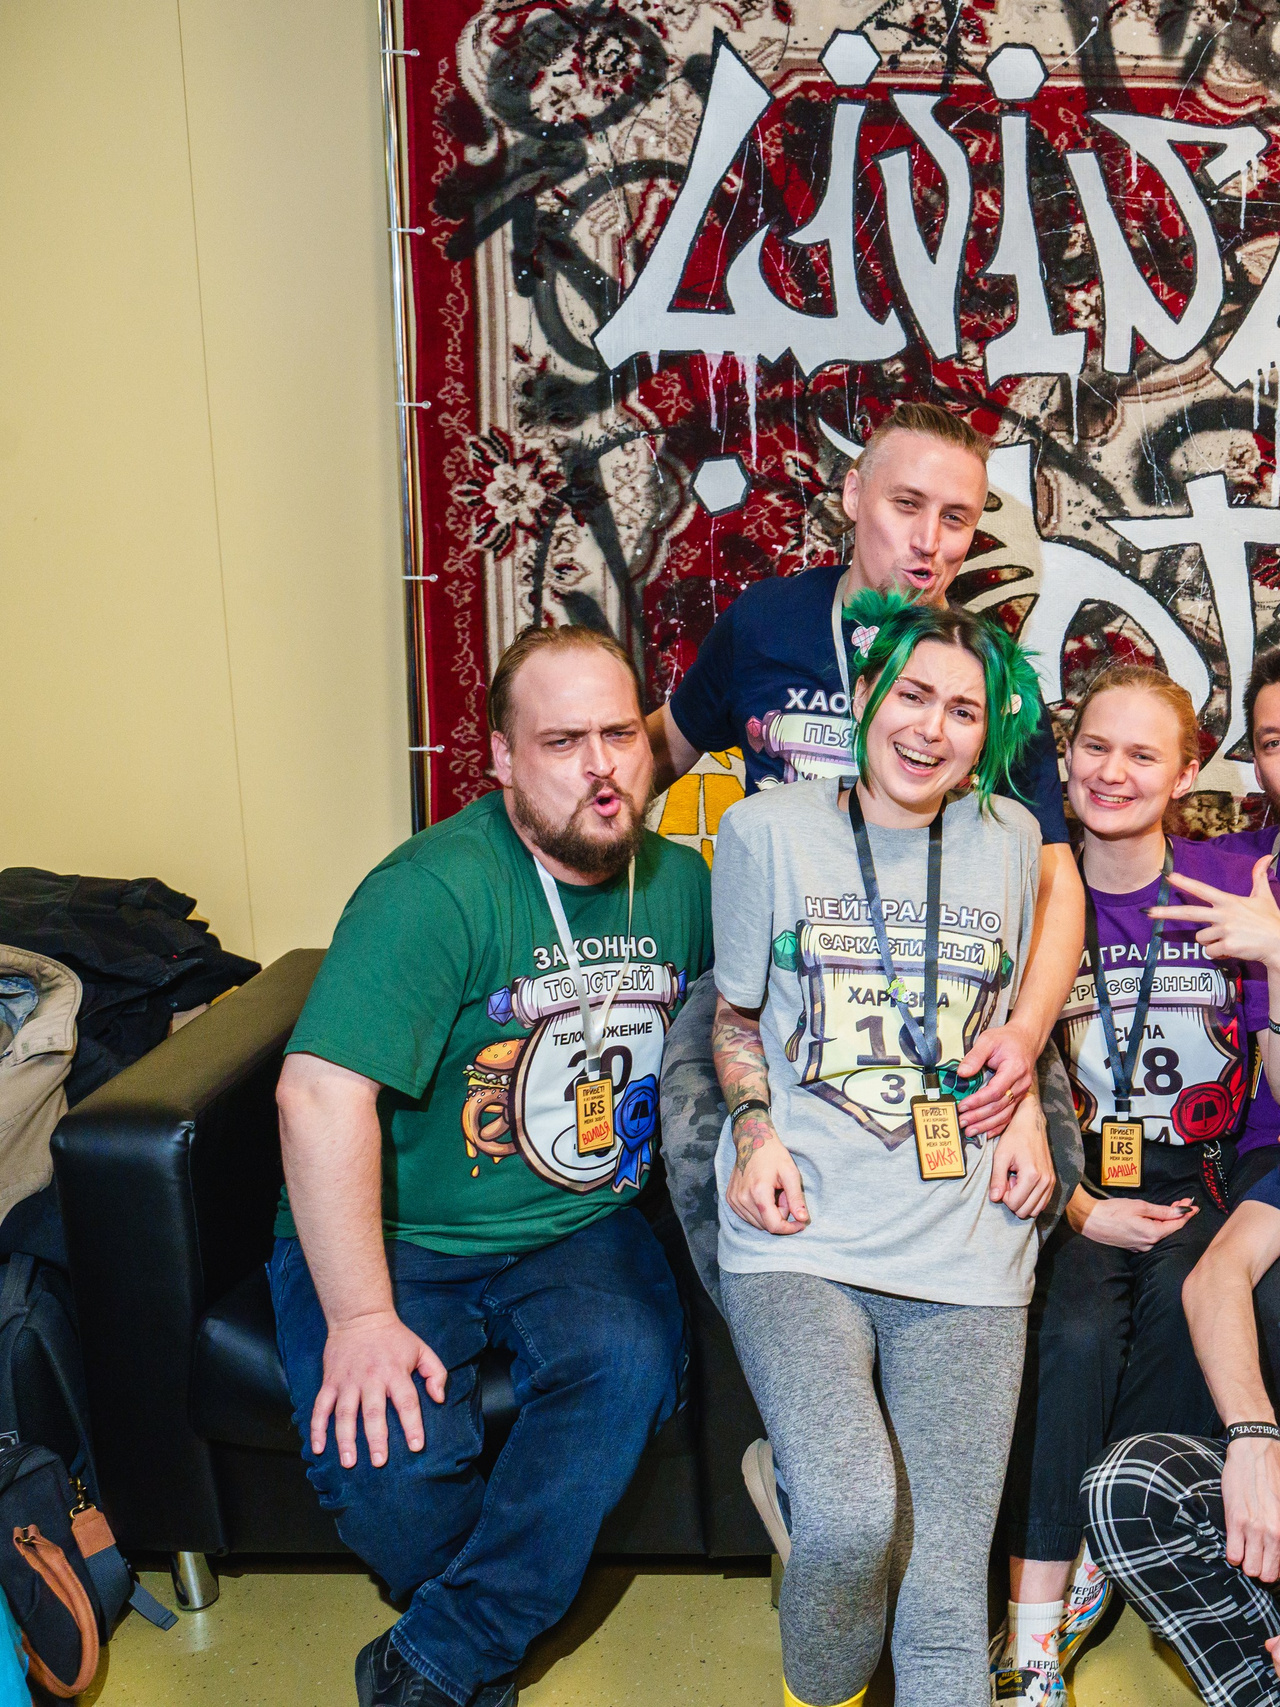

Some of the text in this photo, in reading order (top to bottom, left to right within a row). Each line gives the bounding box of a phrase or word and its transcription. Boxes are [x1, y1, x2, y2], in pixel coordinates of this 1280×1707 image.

[819, 933, 985, 964] САРКАСТИНЫЙ
[848, 986, 950, 1008] ХАРЗА
[553, 1022, 653, 1046] ТЕЛОСЖЕНИЕ
[880, 1074, 906, 1105] 3
[584, 1100, 605, 1117] LRS
[582, 1121, 610, 1145] ВОЛОДЯ
[925, 1124, 950, 1140] LRS
[925, 1147, 958, 1171] ВИКА
[1110, 1141, 1133, 1155] LRS
[1230, 1425, 1280, 1437] УЧАСТНИК
